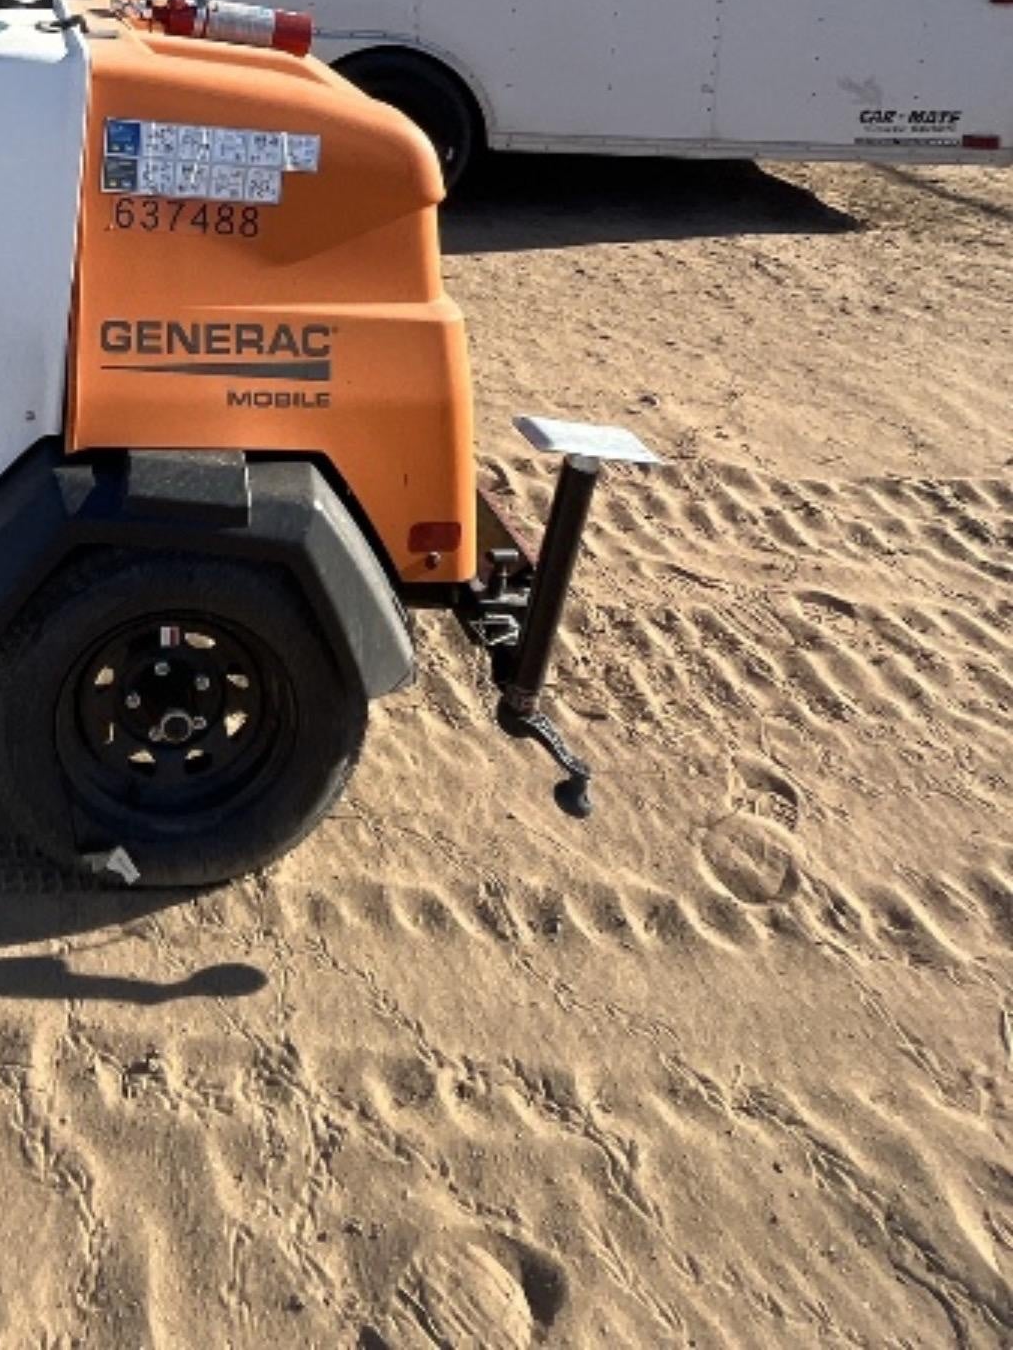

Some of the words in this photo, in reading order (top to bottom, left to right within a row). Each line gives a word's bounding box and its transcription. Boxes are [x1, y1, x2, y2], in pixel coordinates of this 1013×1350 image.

[115, 198, 259, 238] 637488
[100, 320, 331, 357] GENERAC
[226, 392, 330, 408] MOBILE
